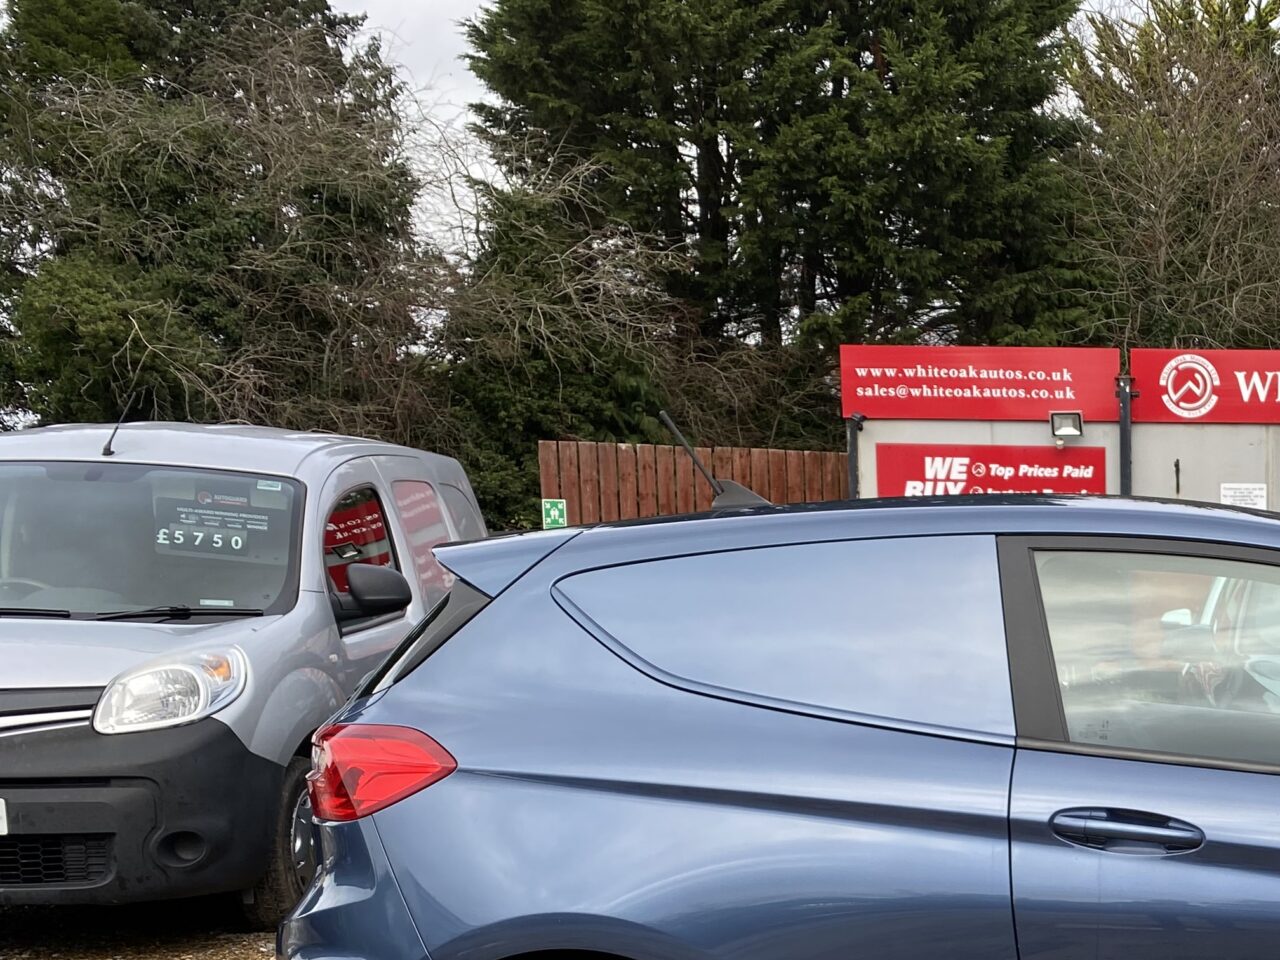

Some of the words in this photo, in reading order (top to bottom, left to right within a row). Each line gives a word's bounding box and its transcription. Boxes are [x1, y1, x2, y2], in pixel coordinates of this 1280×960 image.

[855, 364, 1073, 382] www.whiteoakautos.co.uk
[856, 384, 1076, 400] sales@whiteoakautos.co.uk
[924, 456, 970, 480] WE
[988, 463, 1014, 479] Top
[1018, 464, 1059, 478] Prices
[1062, 465, 1094, 479] Paid
[156, 528, 243, 549] £5750
